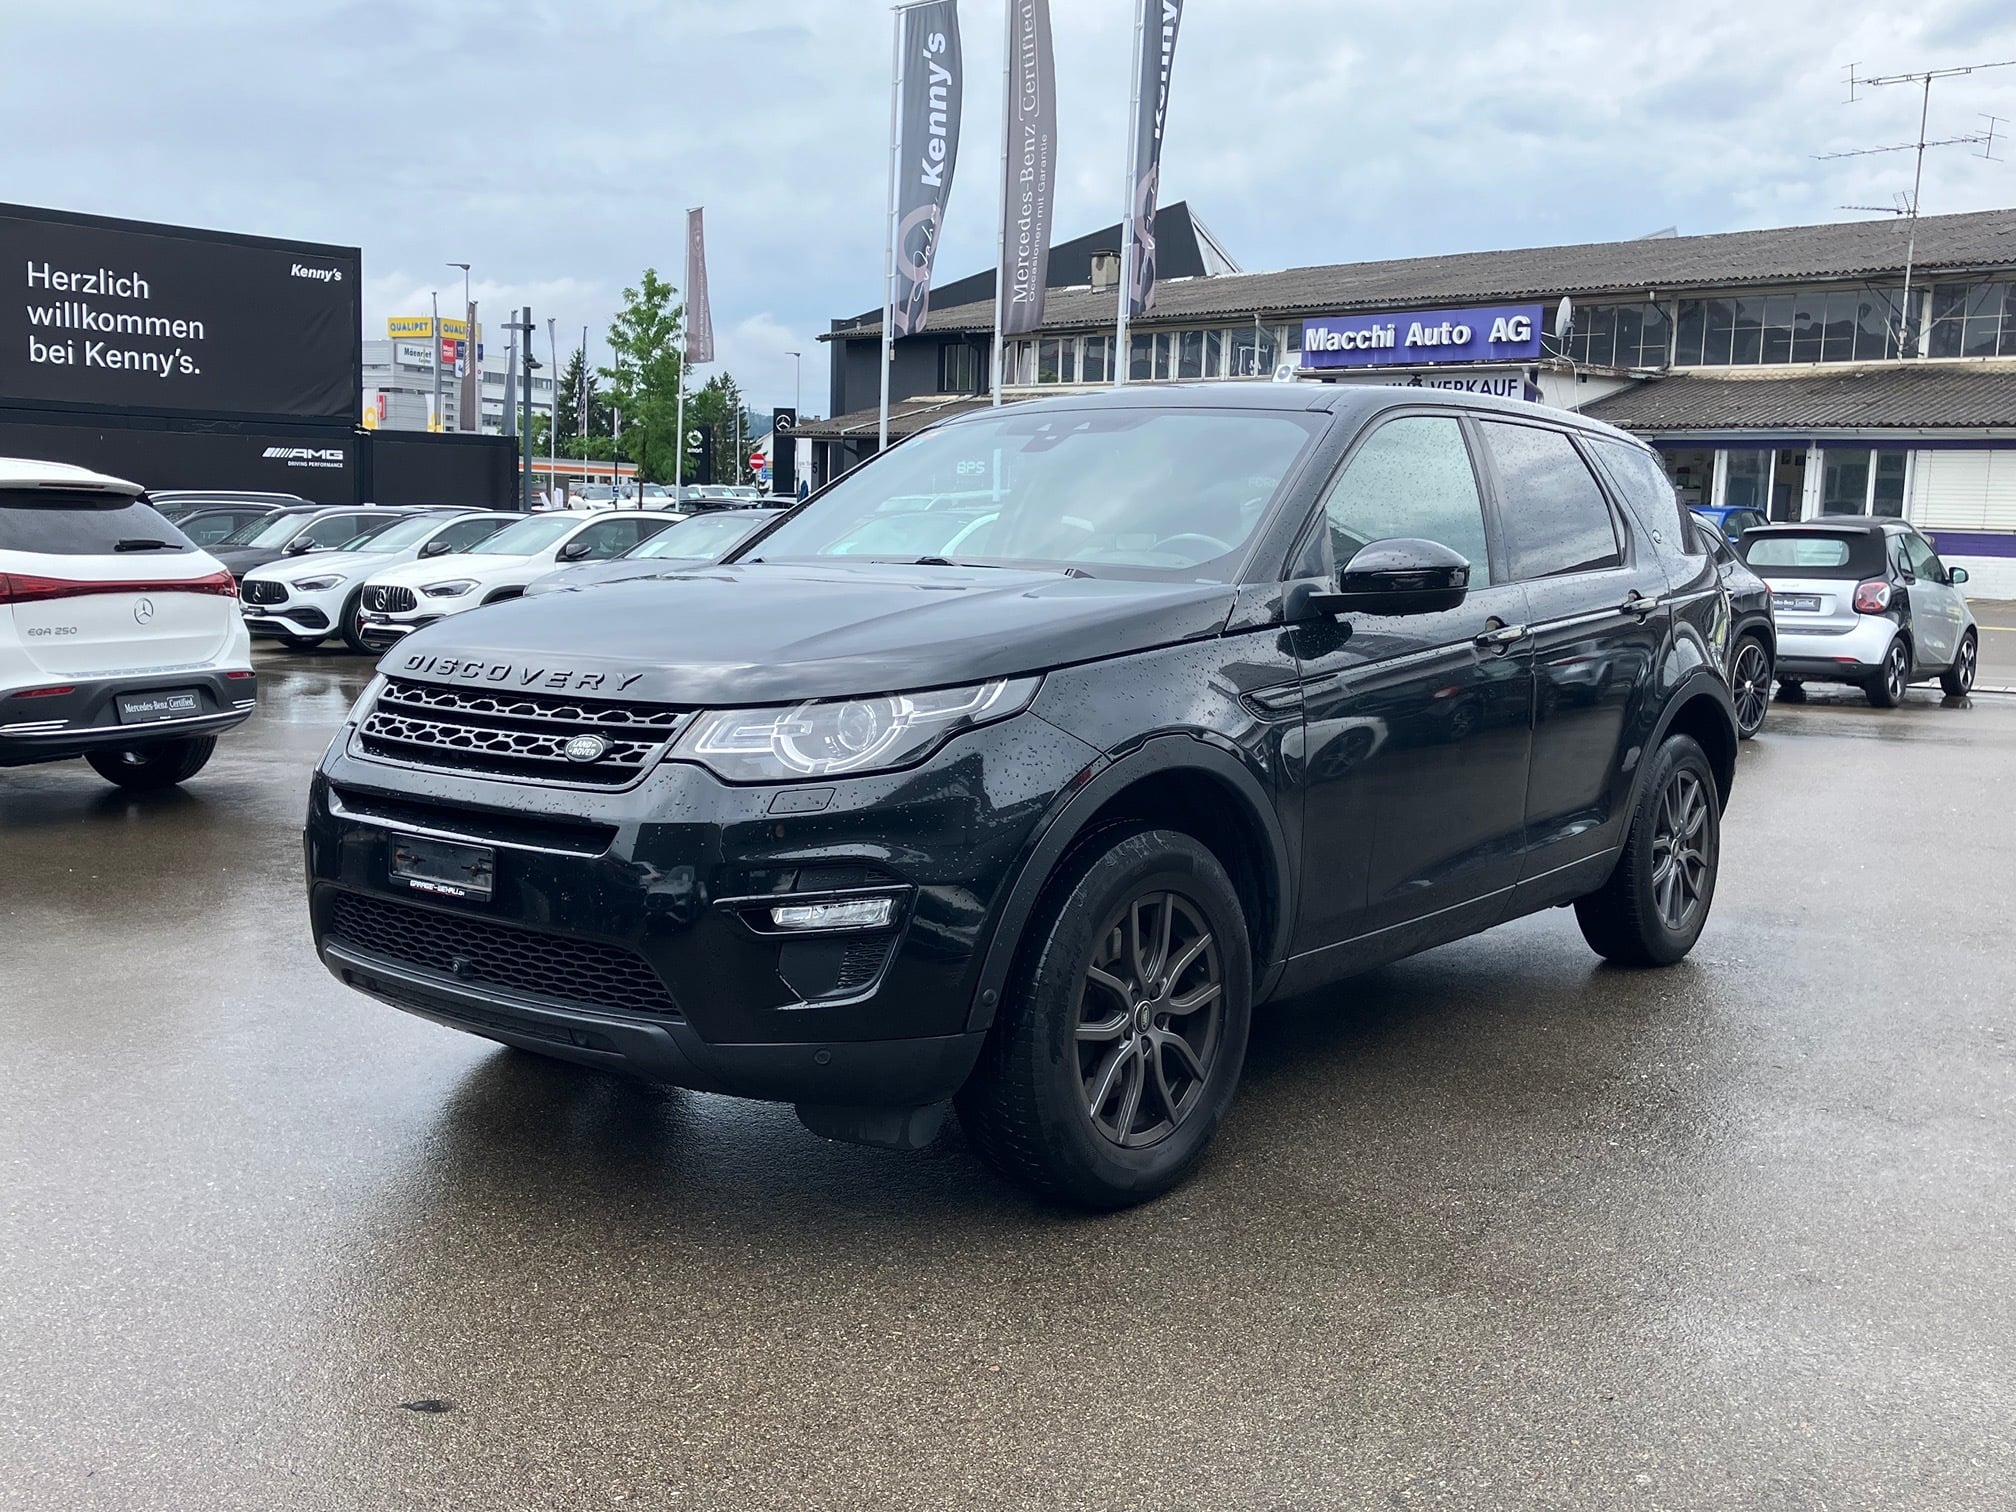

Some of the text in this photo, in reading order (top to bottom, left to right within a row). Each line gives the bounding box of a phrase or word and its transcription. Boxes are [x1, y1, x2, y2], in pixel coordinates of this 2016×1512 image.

[920, 31, 952, 188] Kenny's
[1012, 4, 1036, 304] Mercedes-Benz Certified
[1029, 134, 1048, 302] Occasionen mit Garantie
[27, 261, 149, 299] Herzlich
[291, 263, 342, 282] Kenny's
[27, 302, 204, 340] willkommen
[390, 322, 429, 332] QUALIPET
[1305, 315, 1531, 351] Macchi Auto AG
[29, 336, 201, 377] bei Kenny's.
[28, 626, 78, 636] EQA 250
[402, 654, 644, 692] DISCOVERY
[124, 697, 194, 713] Mercedes-Benz Certified
